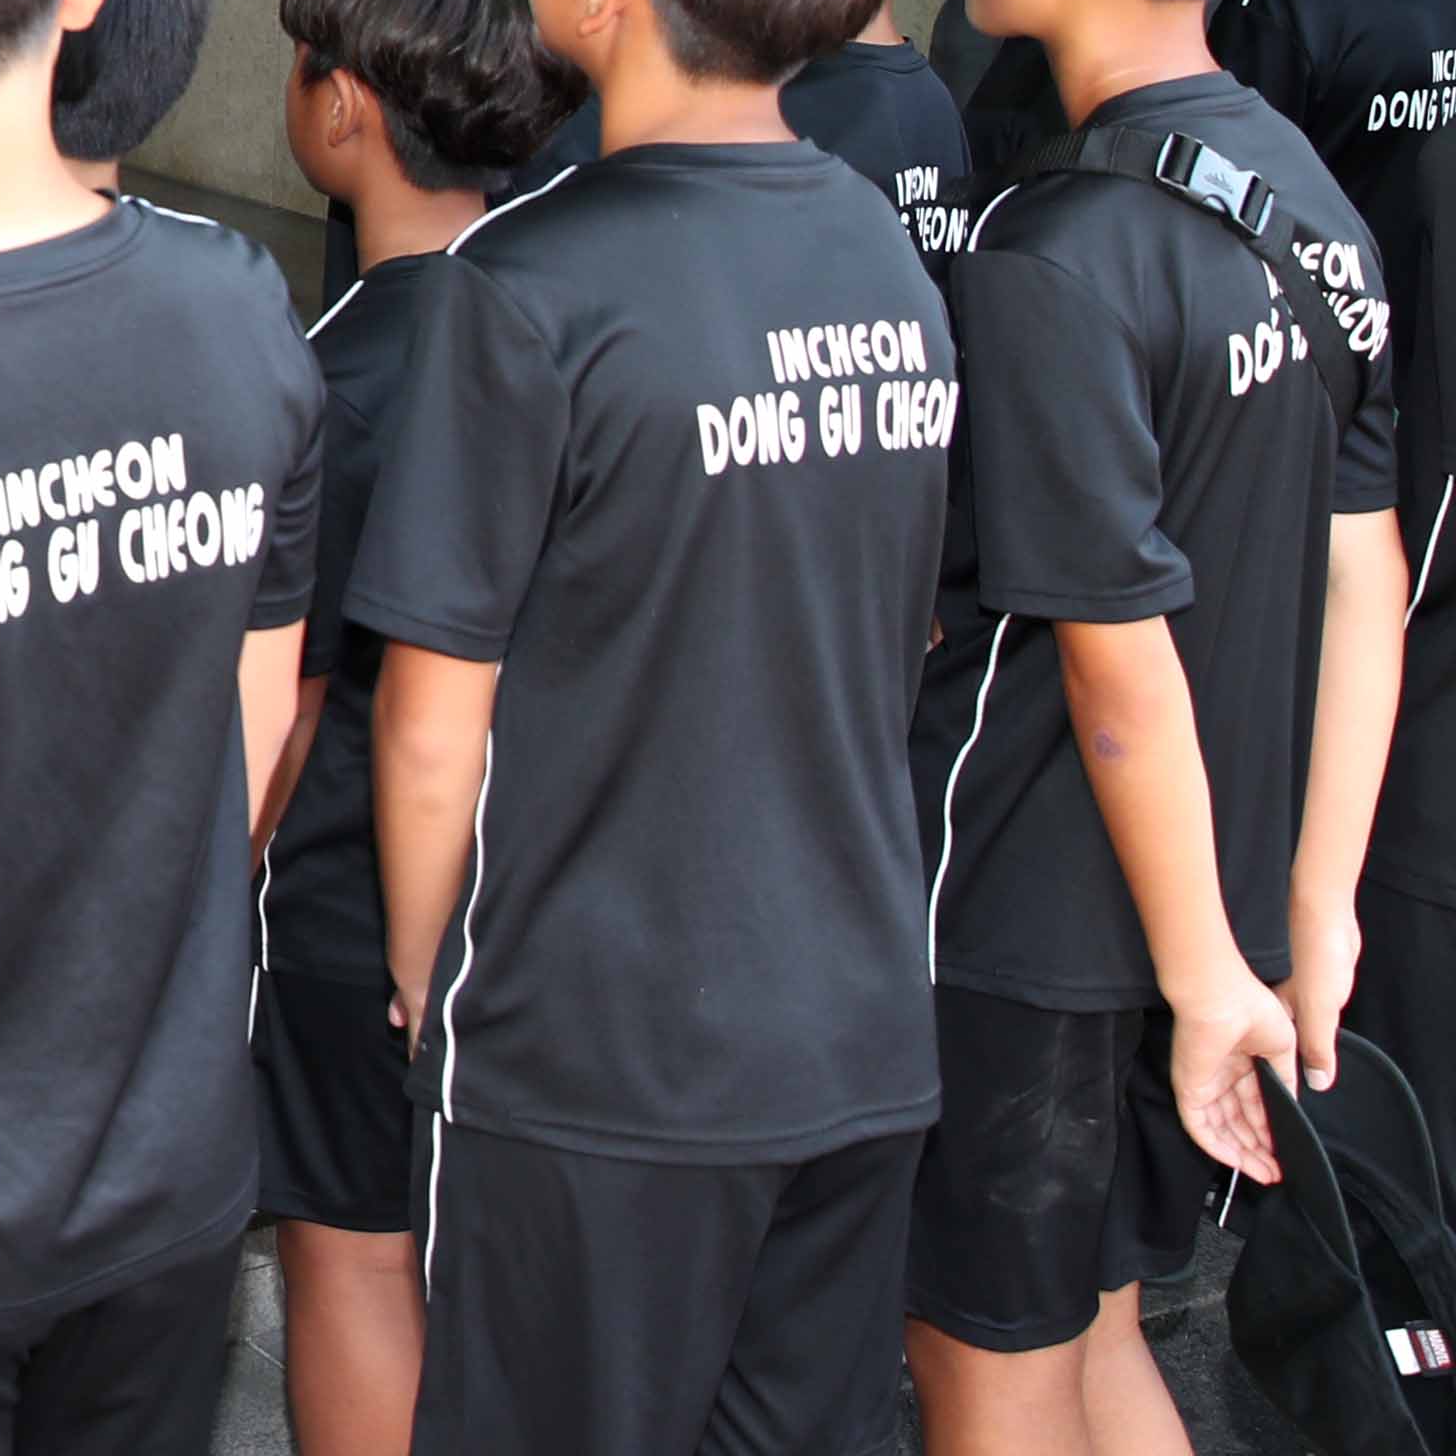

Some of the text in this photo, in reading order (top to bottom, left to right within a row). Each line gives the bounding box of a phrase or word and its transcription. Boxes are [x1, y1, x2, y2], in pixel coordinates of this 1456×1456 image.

[1367, 88, 1438, 132] DONG
[766, 320, 927, 384] INCHEON
[696, 390, 805, 476] DONG
[819, 384, 862, 458] GU
[48, 519, 99, 604] GU
[119, 482, 265, 583] CHEONG
